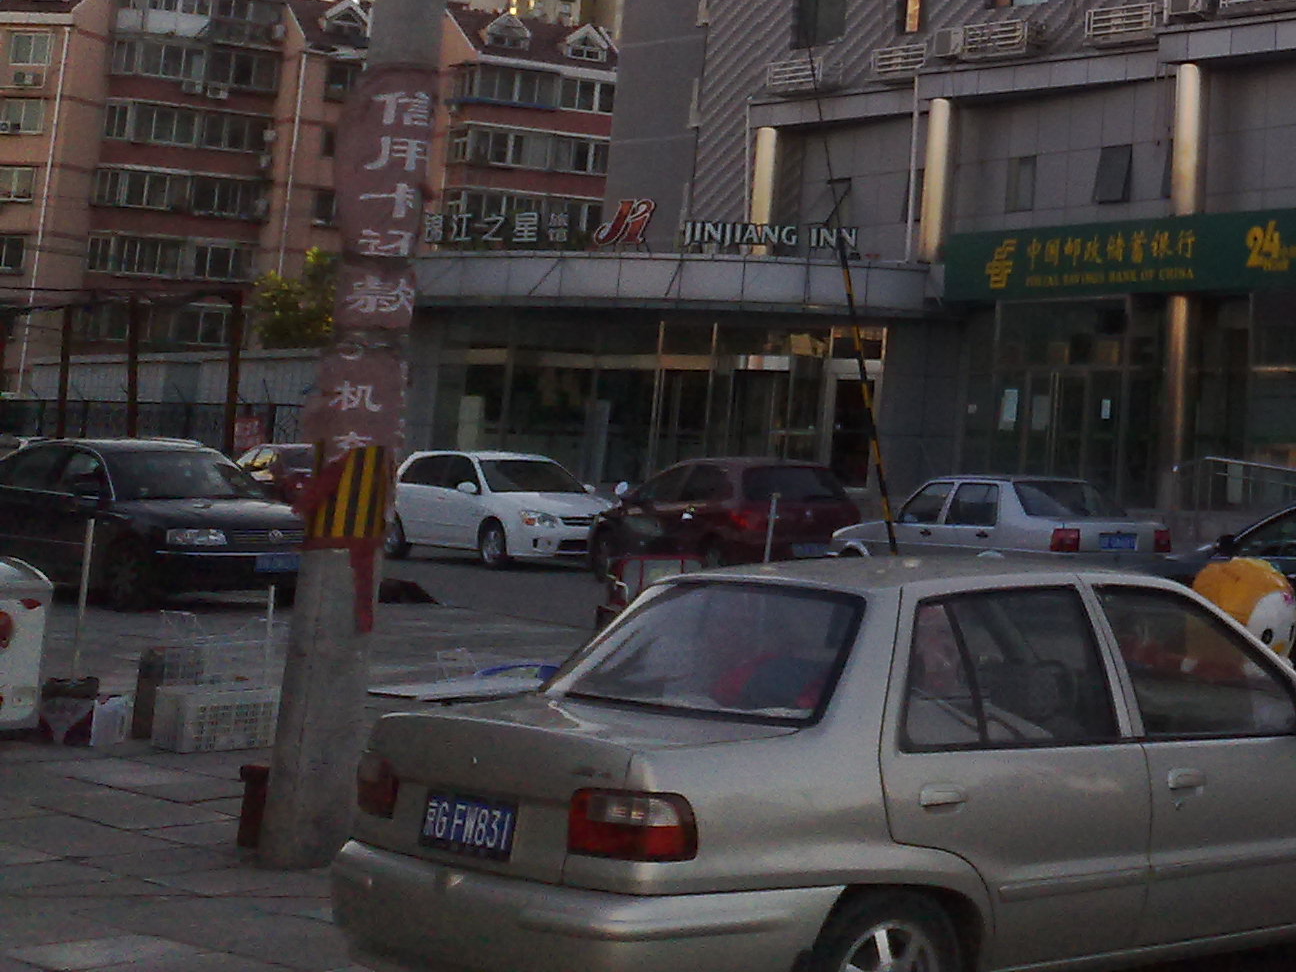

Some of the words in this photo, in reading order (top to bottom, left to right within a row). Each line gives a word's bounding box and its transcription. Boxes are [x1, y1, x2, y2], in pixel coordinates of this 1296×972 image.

[424, 212, 540, 243] 锦江之星
[683, 221, 799, 246] JINJIANG
[809, 227, 859, 248] INN
[1026, 229, 1197, 271] 中国邮政储蓄银行
